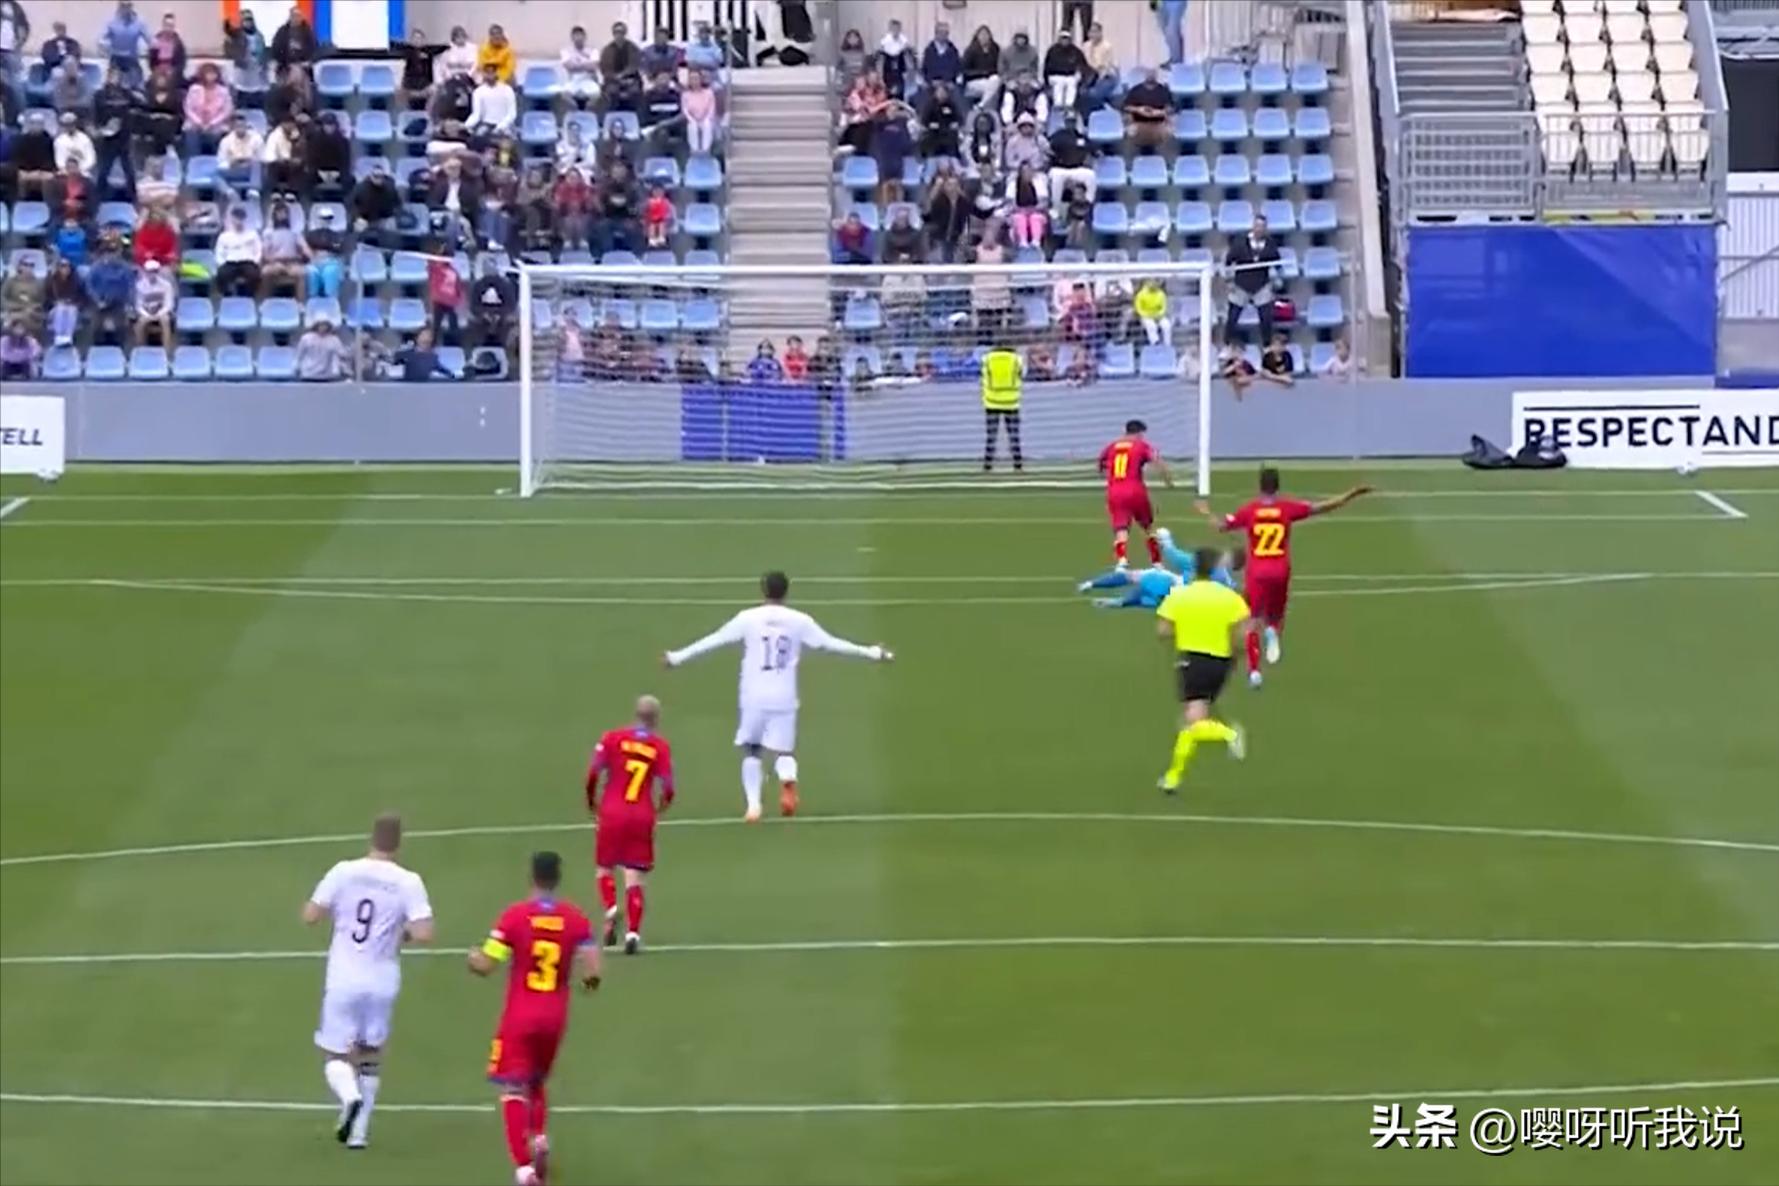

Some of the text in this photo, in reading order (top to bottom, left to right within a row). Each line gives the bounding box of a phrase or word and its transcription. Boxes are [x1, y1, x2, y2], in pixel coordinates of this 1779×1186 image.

[1253, 523, 1285, 557] 22
[625, 760, 649, 801] 7
[352, 898, 375, 944] 9
[526, 940, 561, 992] 3
